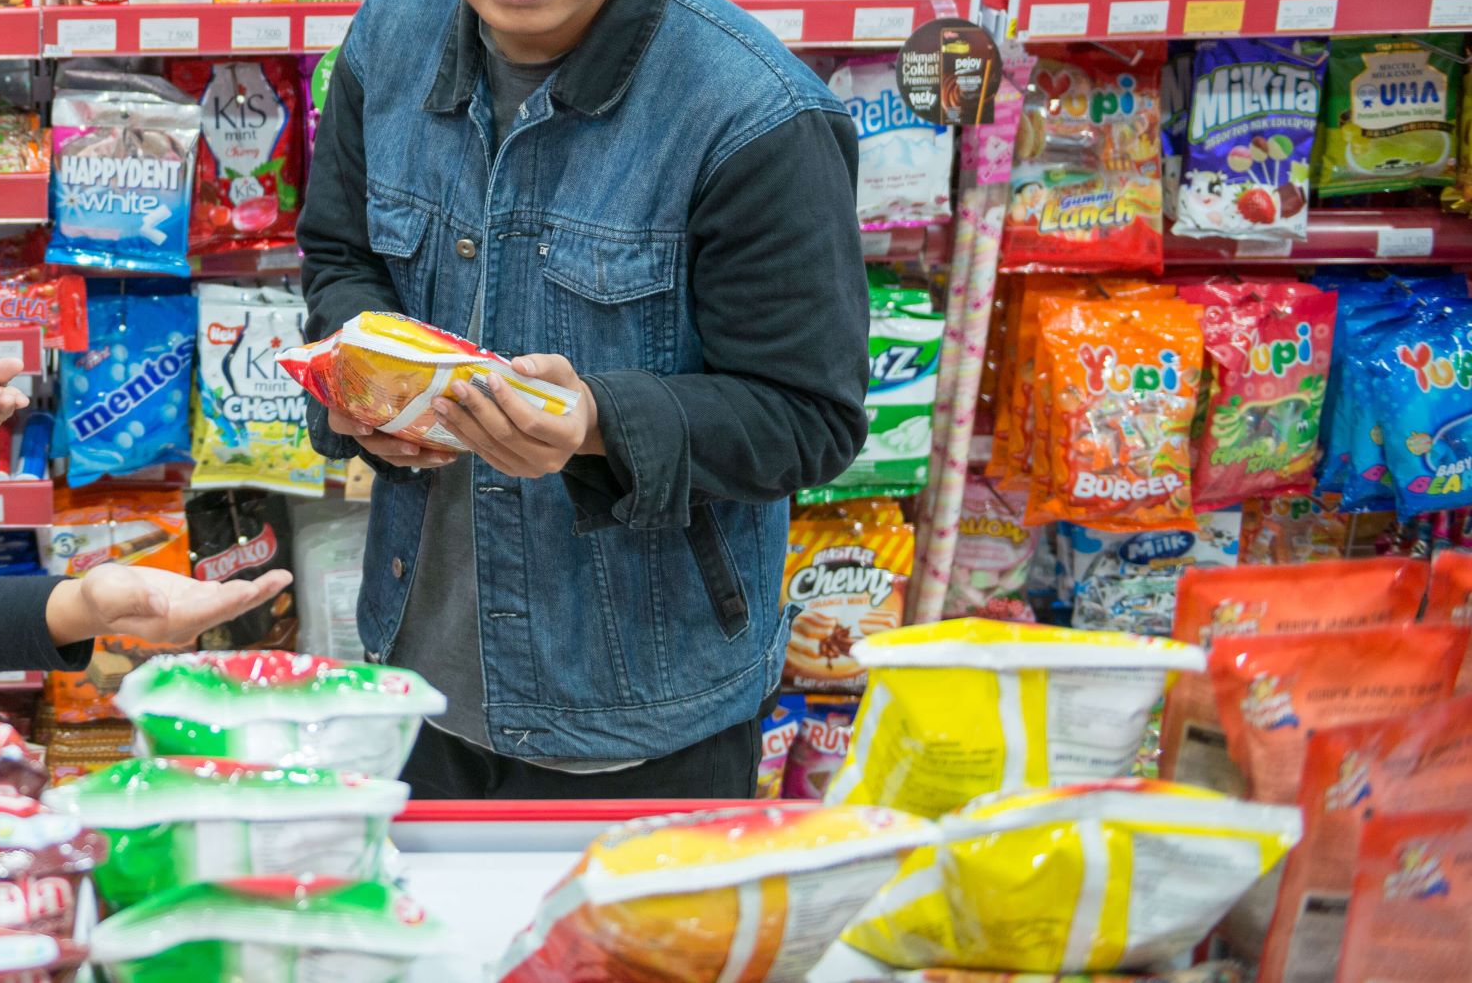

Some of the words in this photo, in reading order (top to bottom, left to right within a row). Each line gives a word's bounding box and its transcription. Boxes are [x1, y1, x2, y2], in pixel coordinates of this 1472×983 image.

[902, 52, 940, 63] Nikmati
[902, 64, 940, 76] Coklat
[954, 56, 982, 71] pejoy
[902, 75, 940, 86] Premium
[1379, 80, 1440, 106] UHA
[1035, 68, 1140, 125] Yupi
[224, 130, 258, 142] mint
[61, 154, 182, 191] HAPPYDENT
[76, 190, 160, 217] white
[1060, 190, 1115, 210] Gummi
[1038, 198, 1140, 234] Lunch
[1231, 322, 1312, 379] Yupi
[1077, 341, 1182, 397] Yupi
[69, 333, 195, 442] mentos
[254, 381, 288, 393] mint
[1072, 471, 1184, 502] BURGER
[202, 539, 271, 580] KOPIKO
[1128, 533, 1191, 560] Milk
[788, 565, 894, 607] Chewy
